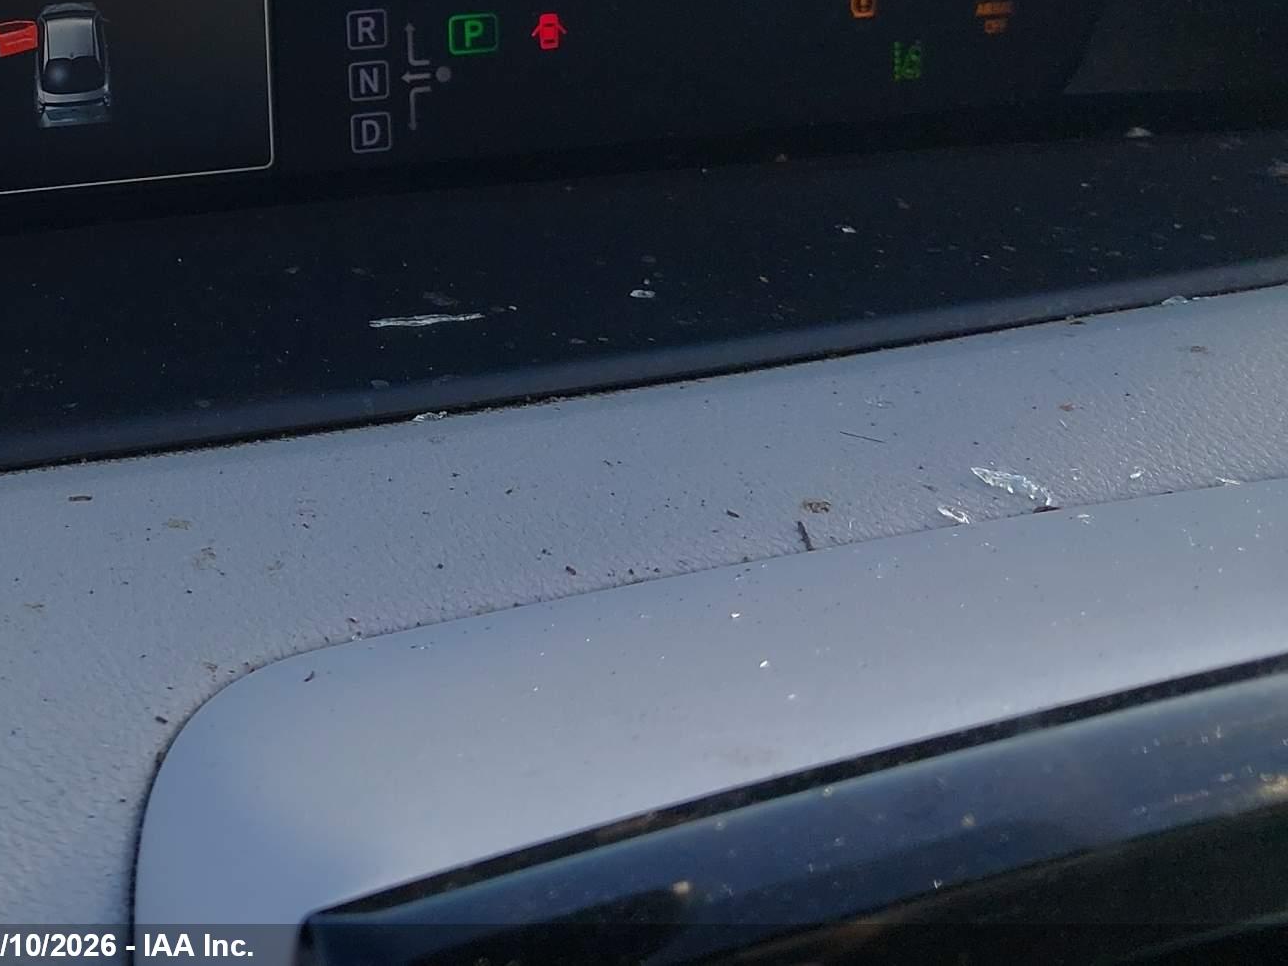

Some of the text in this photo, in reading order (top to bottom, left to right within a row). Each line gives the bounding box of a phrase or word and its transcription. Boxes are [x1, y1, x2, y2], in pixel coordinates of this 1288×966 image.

[356, 16, 377, 44] R
[463, 20, 485, 49] P
[358, 67, 380, 95] N
[361, 119, 381, 147] D
